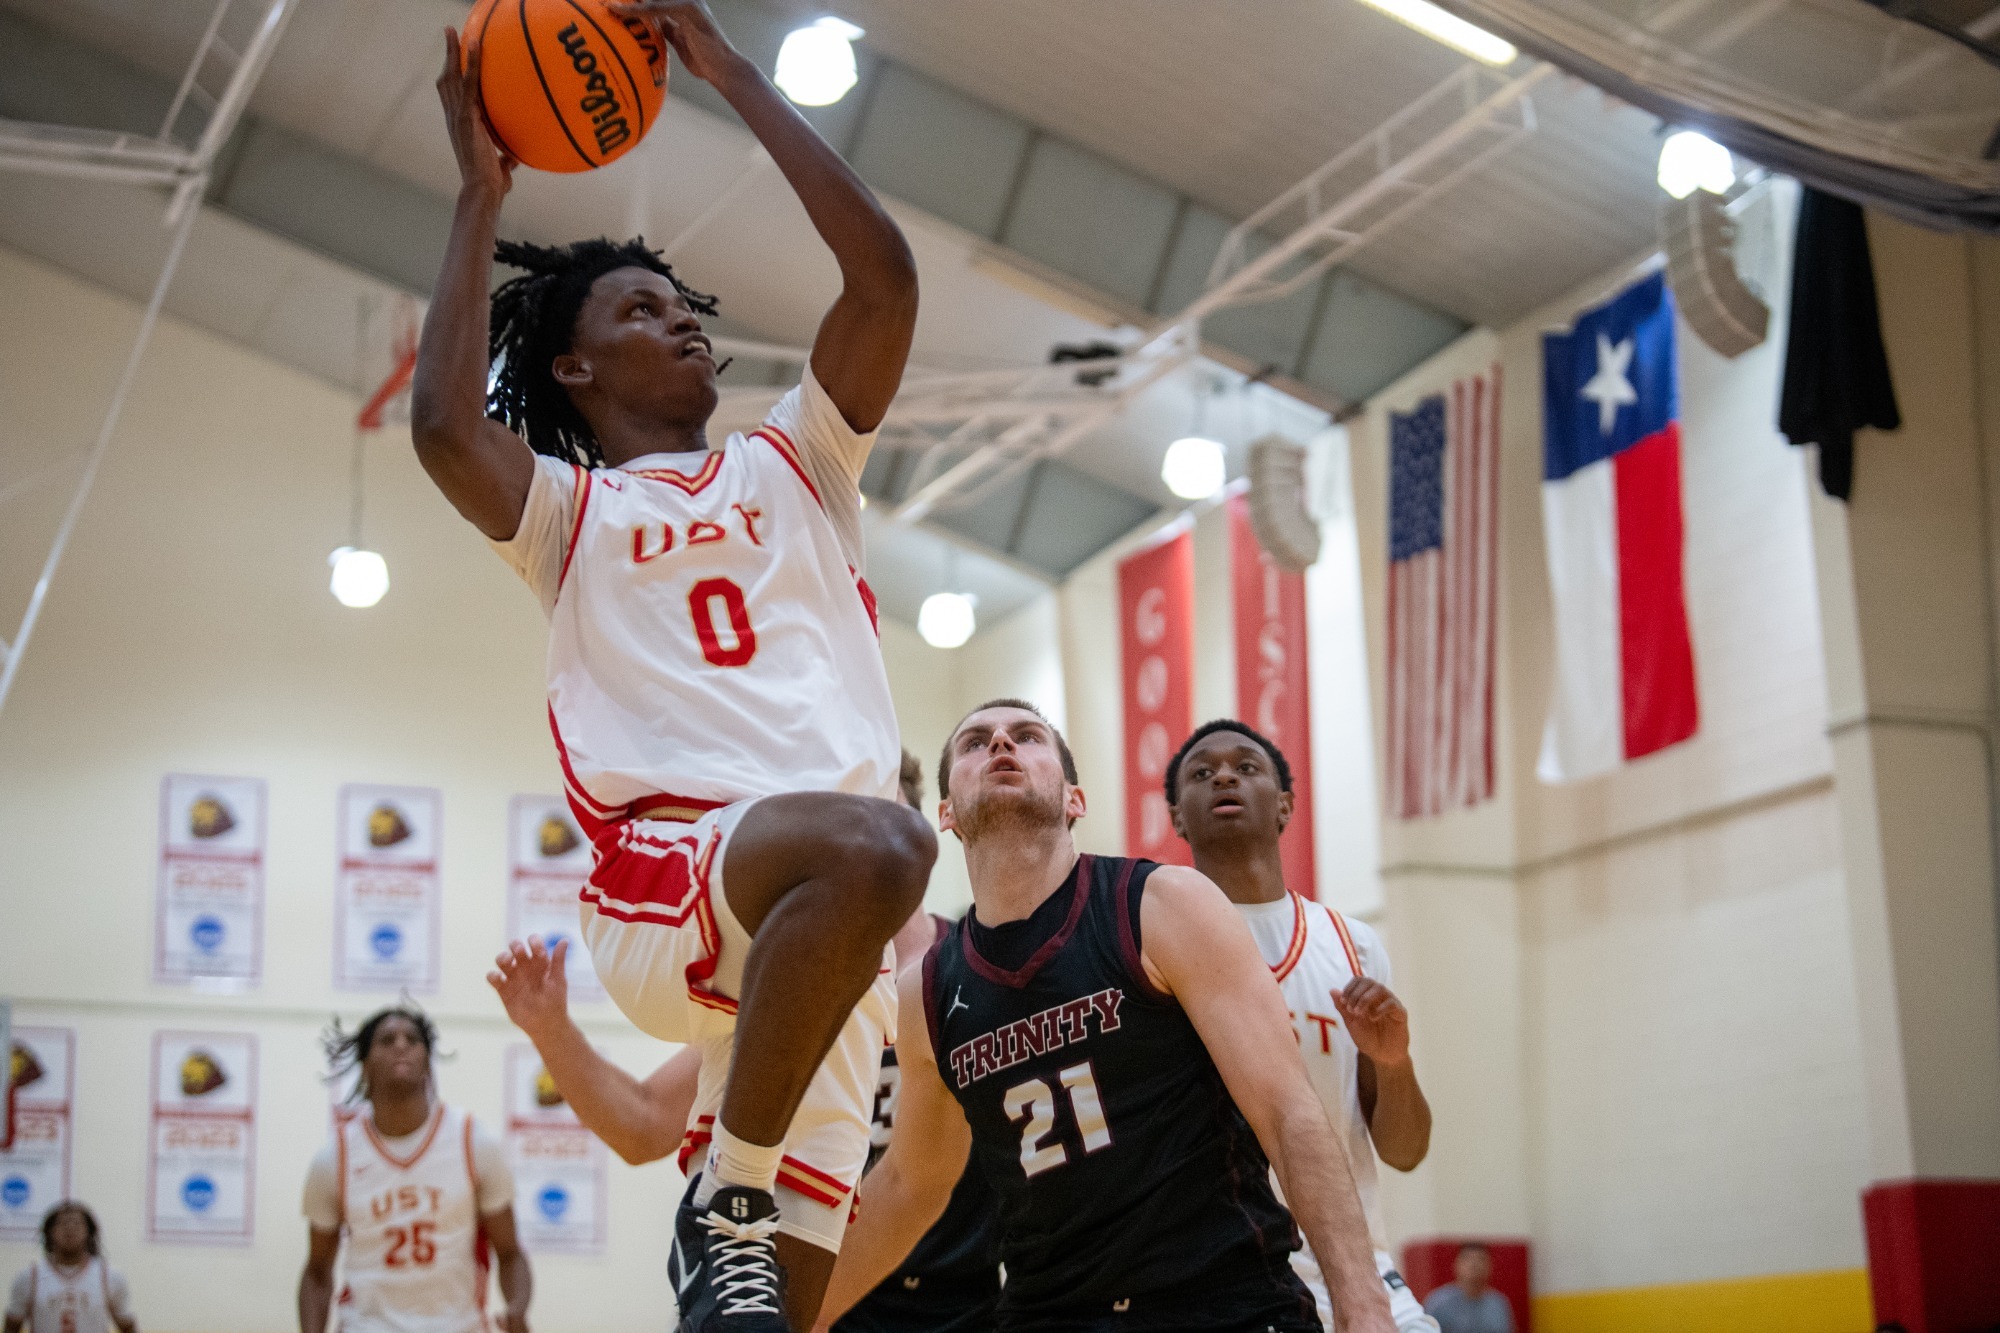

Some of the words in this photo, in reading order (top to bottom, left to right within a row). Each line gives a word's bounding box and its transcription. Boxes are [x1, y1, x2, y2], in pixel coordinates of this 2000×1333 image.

[557, 20, 631, 156] Wilson
[632, 503, 763, 564] UST
[687, 576, 757, 667] 0
[1135, 586, 1170, 856] GOOD
[950, 987, 1125, 1089] TRINITY
[1002, 1057, 1115, 1180] 21
[370, 1184, 442, 1221] UST
[383, 1221, 437, 1268] 25
